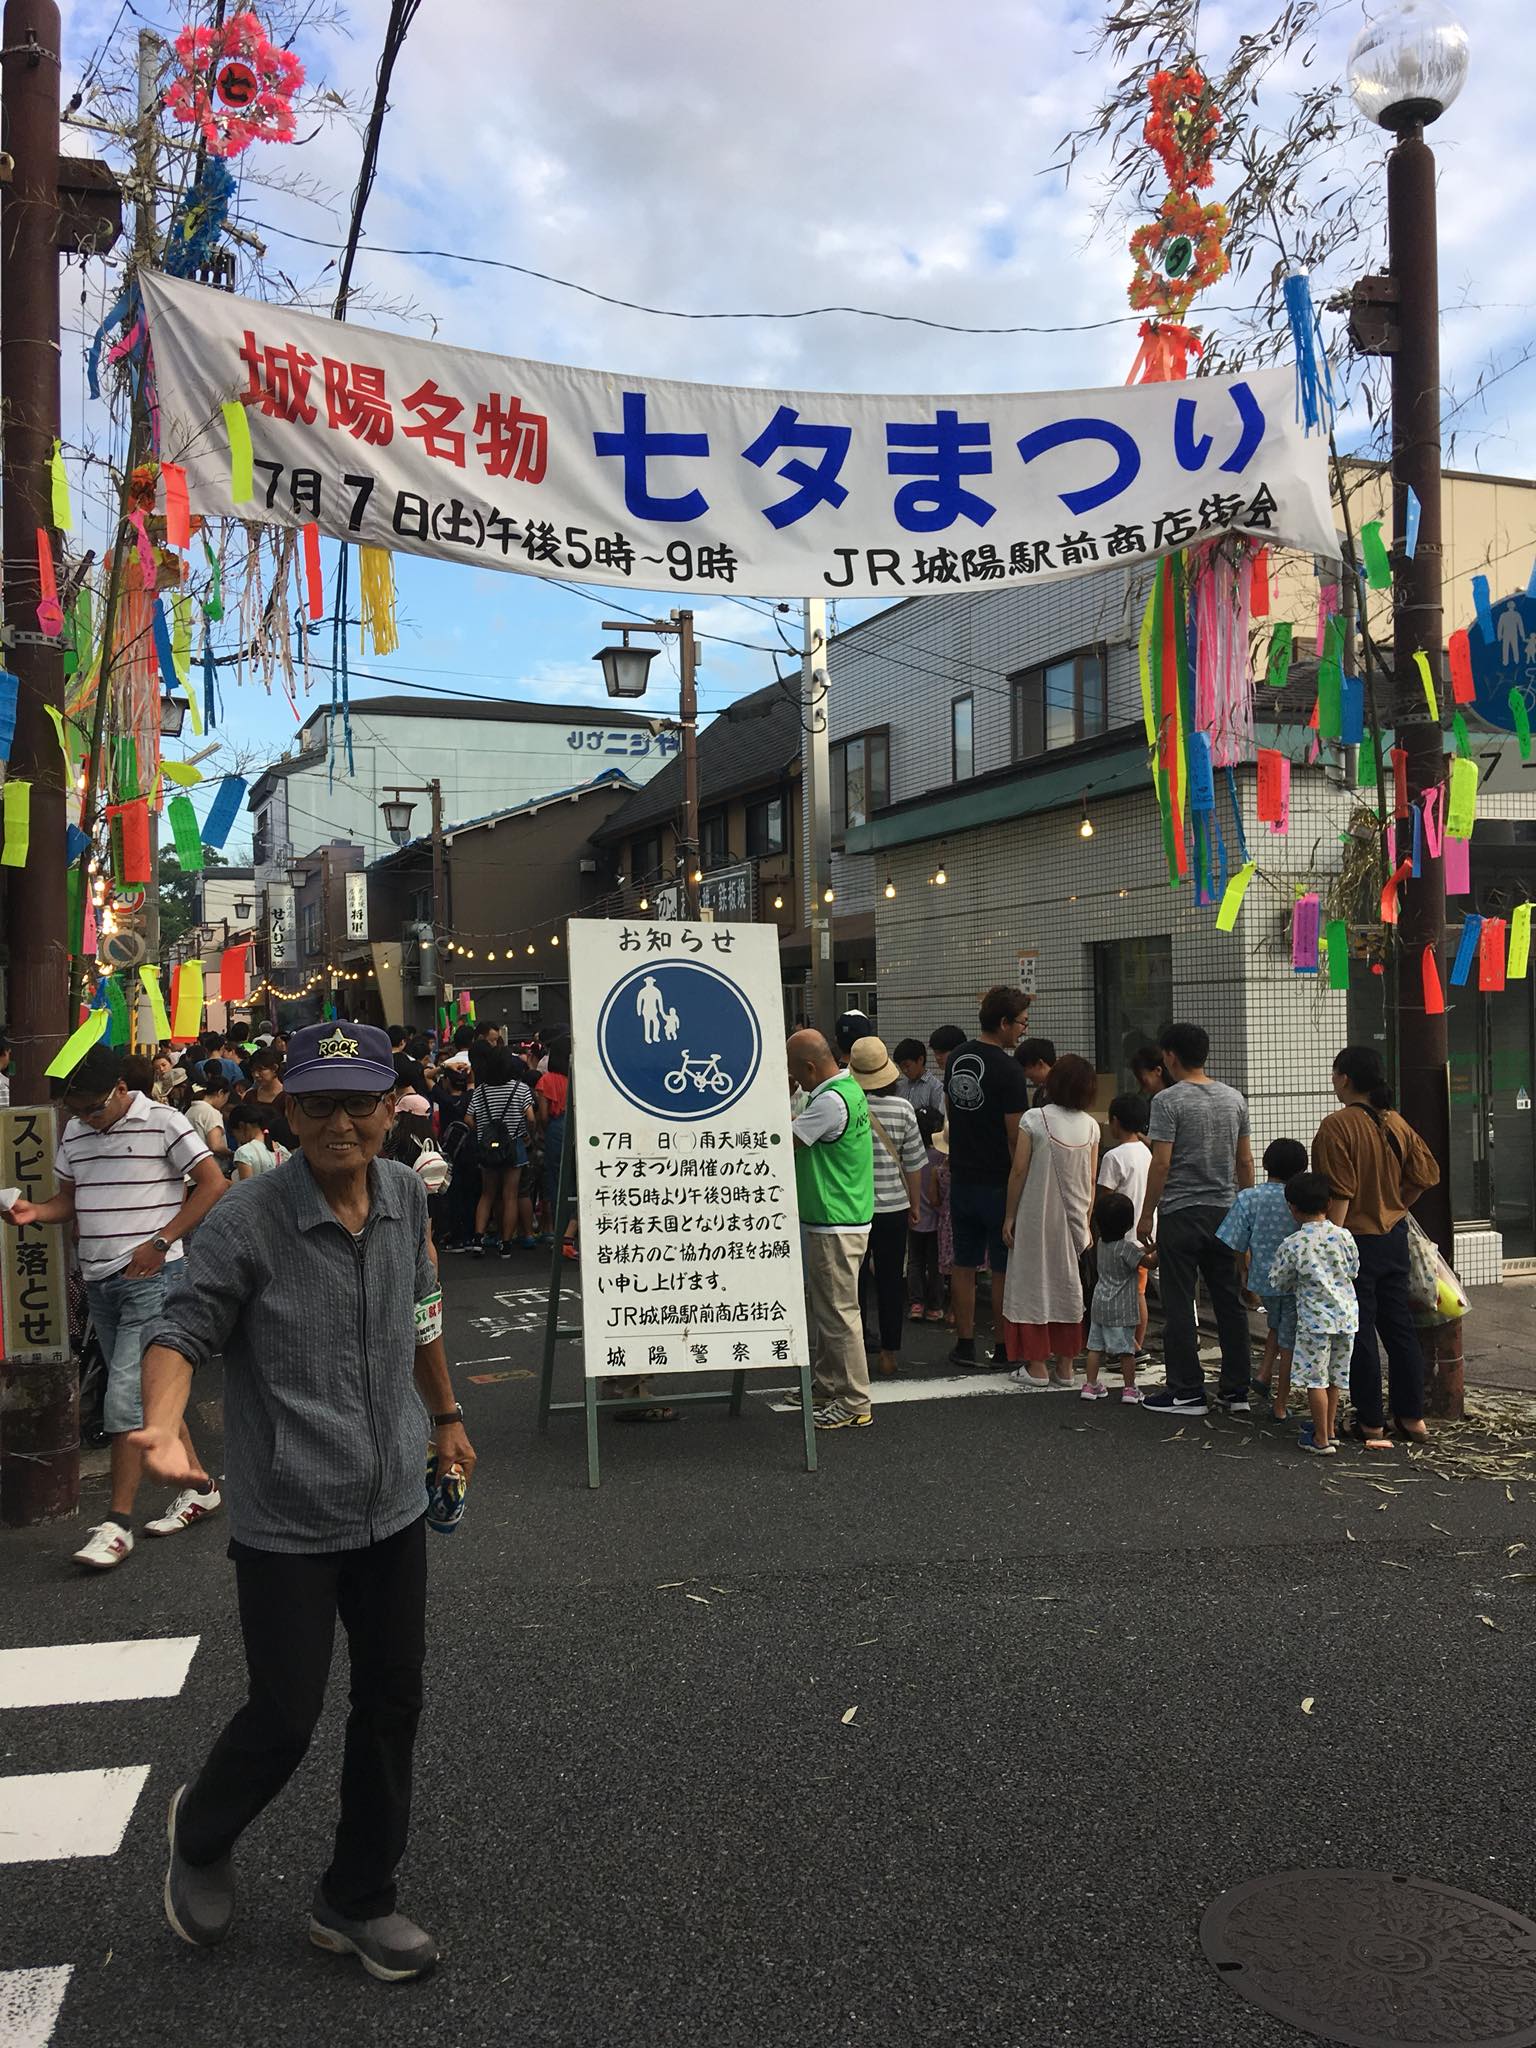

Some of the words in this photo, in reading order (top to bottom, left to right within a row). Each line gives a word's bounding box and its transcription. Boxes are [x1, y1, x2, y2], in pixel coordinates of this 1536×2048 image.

[239, 330, 548, 485] 城陽名物
[593, 381, 1266, 533] 七夕まつり
[822, 481, 1278, 588] JR城陽駅前商店街会
[271, 908, 285, 957] せんりき
[619, 926, 736, 953] お知らせ
[318, 1041, 359, 1055] ROCK
[595, 1158, 777, 1178] 七夕まつり開催のため、
[595, 1185, 784, 1206] 午後5時より午後9時まで
[595, 1212, 787, 1235] 歩行者天国となりますので
[597, 1240, 791, 1264] 皆様方のご協力の程をお願
[599, 1271, 727, 1294] い申し上げます。
[607, 1300, 787, 1327] JR城陽駅前商店街会
[607, 1340, 791, 1367] 城陽警察署
